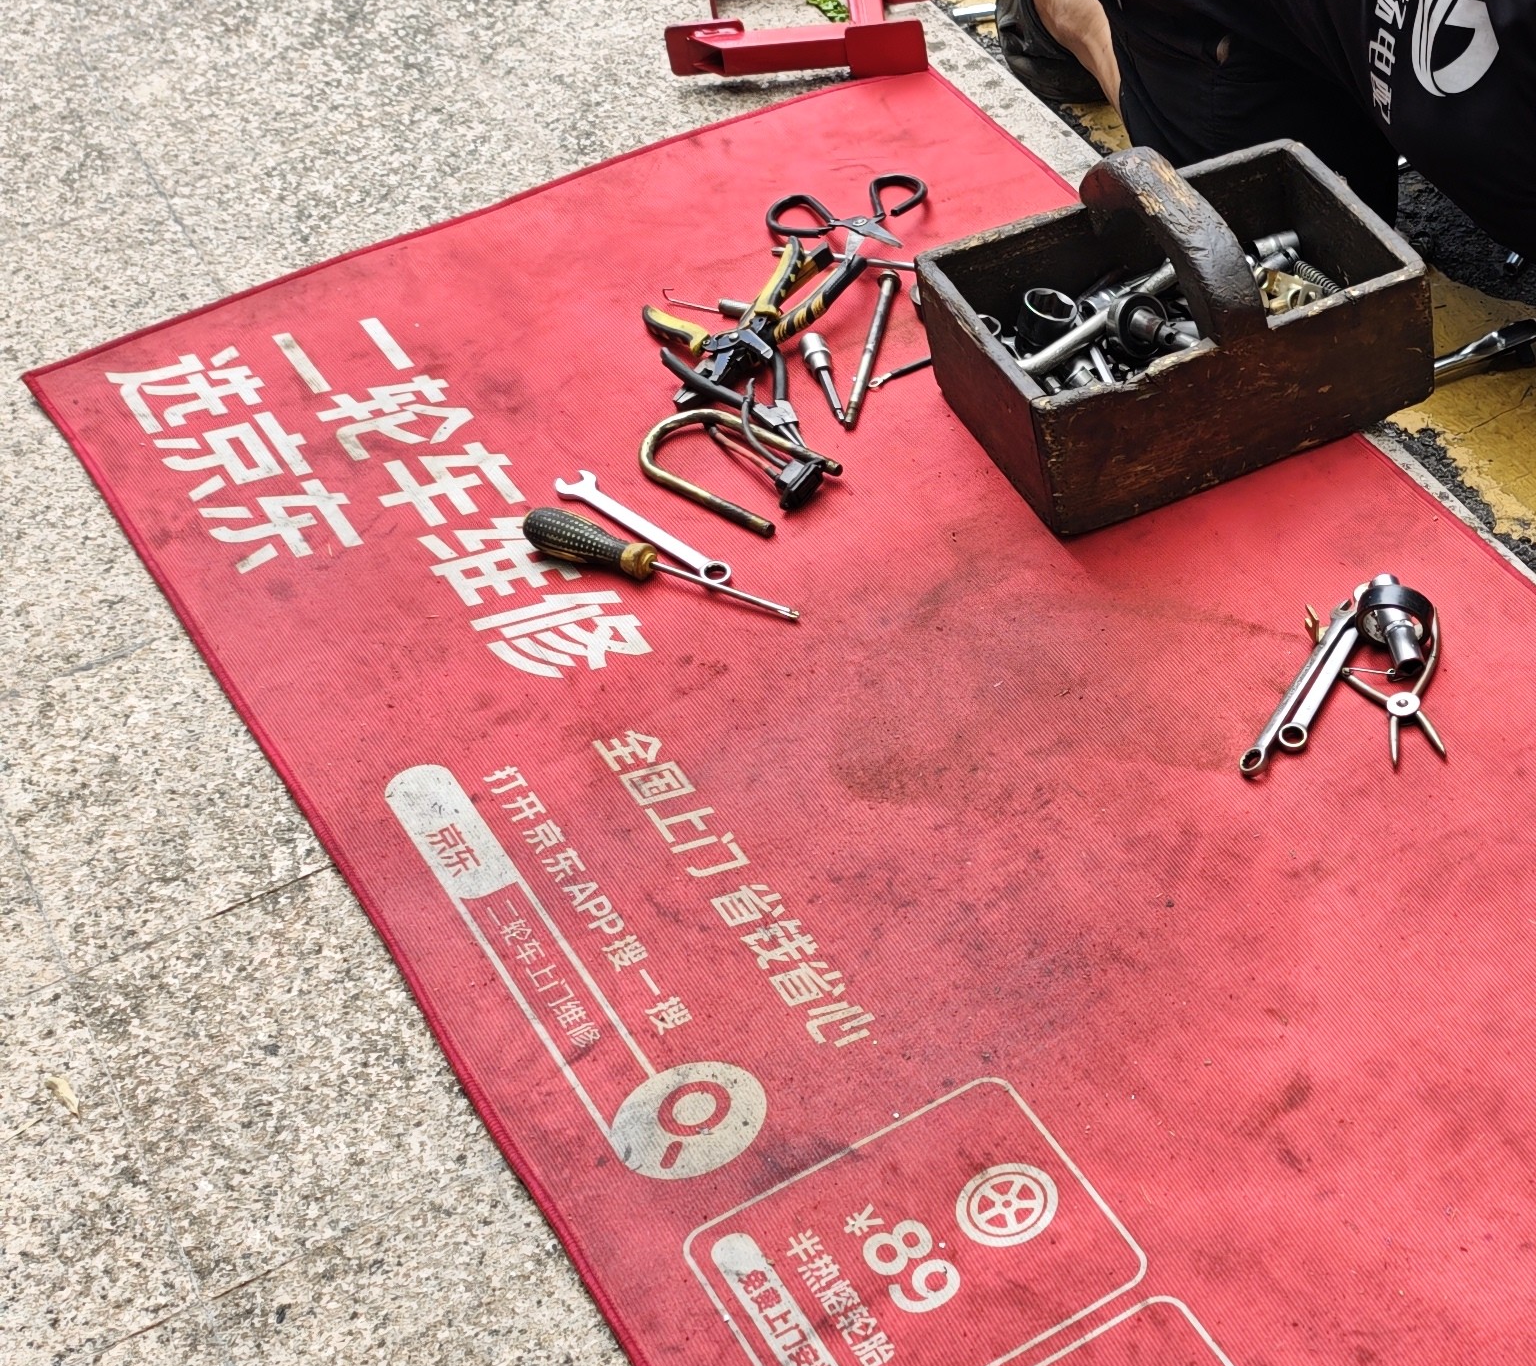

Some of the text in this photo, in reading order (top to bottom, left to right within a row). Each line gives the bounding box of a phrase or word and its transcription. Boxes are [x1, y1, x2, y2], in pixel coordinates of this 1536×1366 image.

[105, 345, 363, 574] 选京东
[272, 317, 653, 679] 二轮车维修
[426, 823, 481, 877] 京东
[483, 765, 693, 1035] 打开京东APP搜一搜
[487, 899, 601, 1047] 二轮车上门维修
[843, 1203, 961, 1313] ¥89
